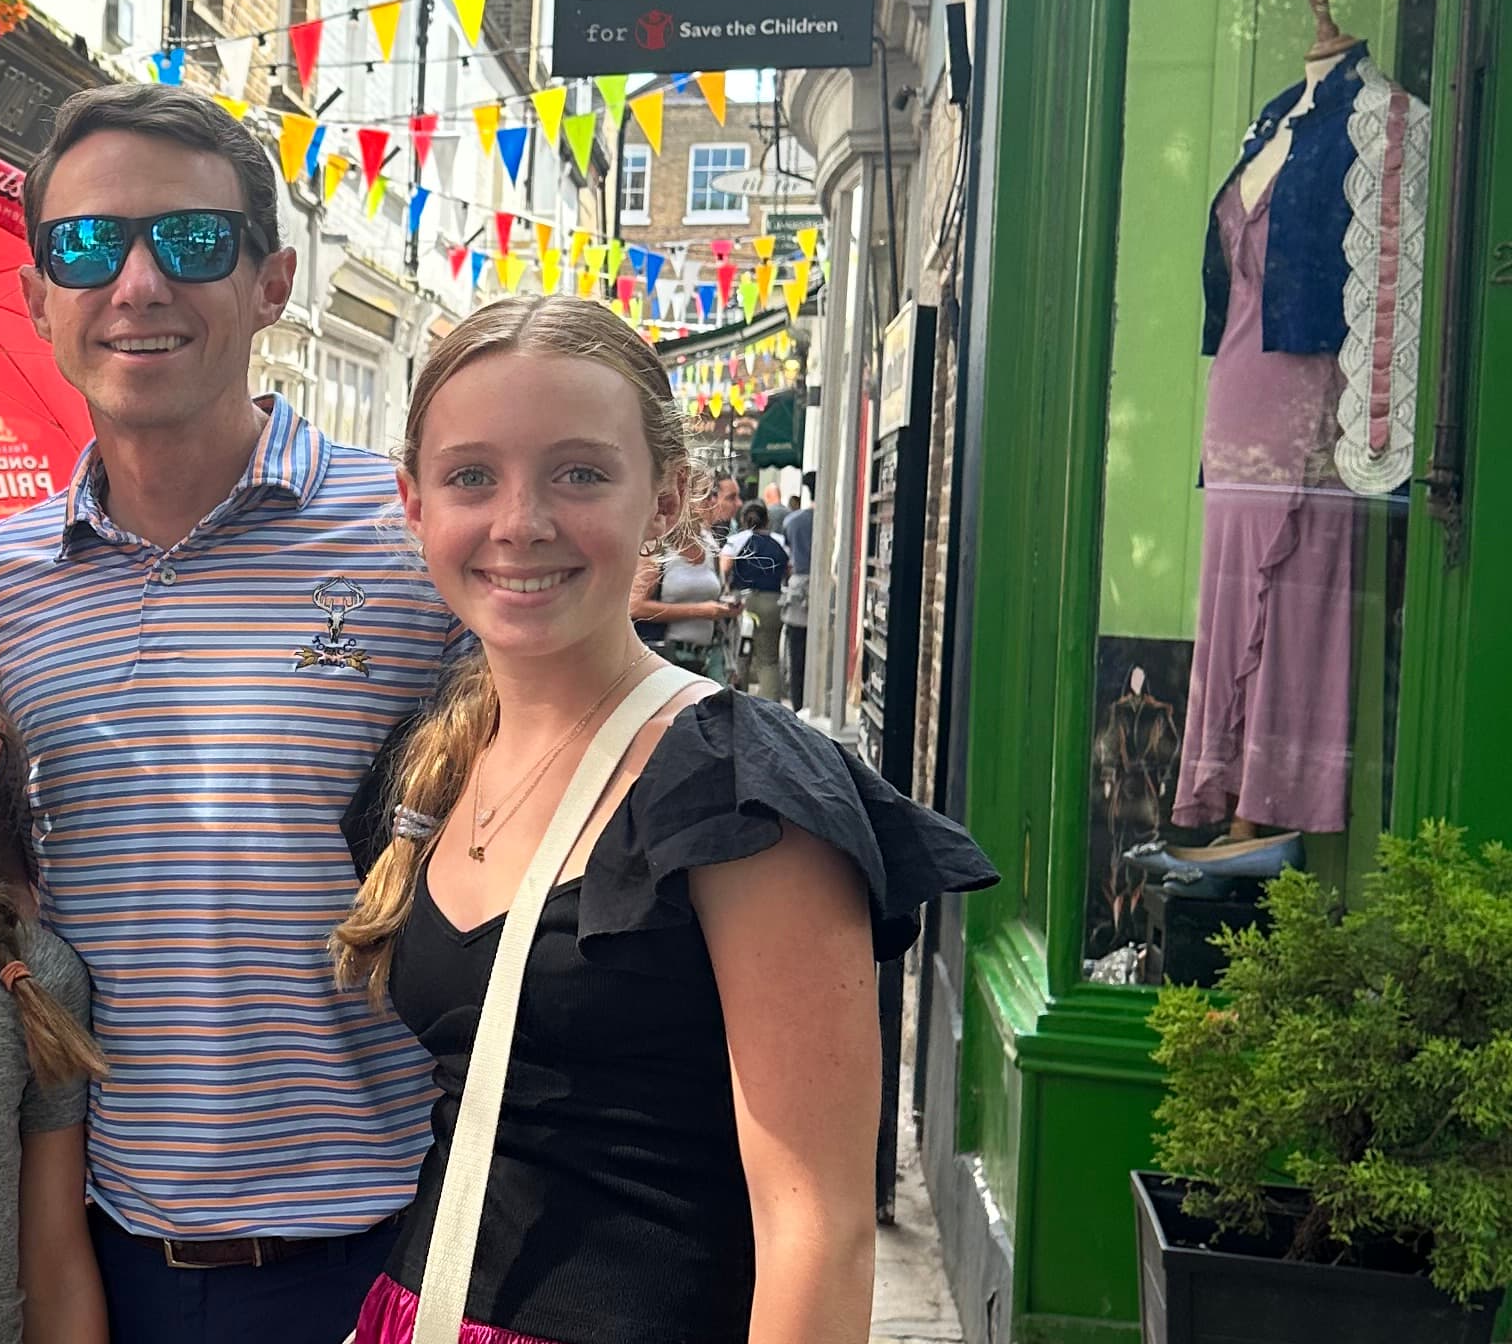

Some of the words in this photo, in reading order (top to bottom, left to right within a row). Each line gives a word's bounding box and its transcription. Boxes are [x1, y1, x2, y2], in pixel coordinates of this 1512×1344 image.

[586, 24, 628, 43] for
[679, 21, 723, 39] Save
[726, 20, 757, 37] the
[759, 16, 839, 36] Children
